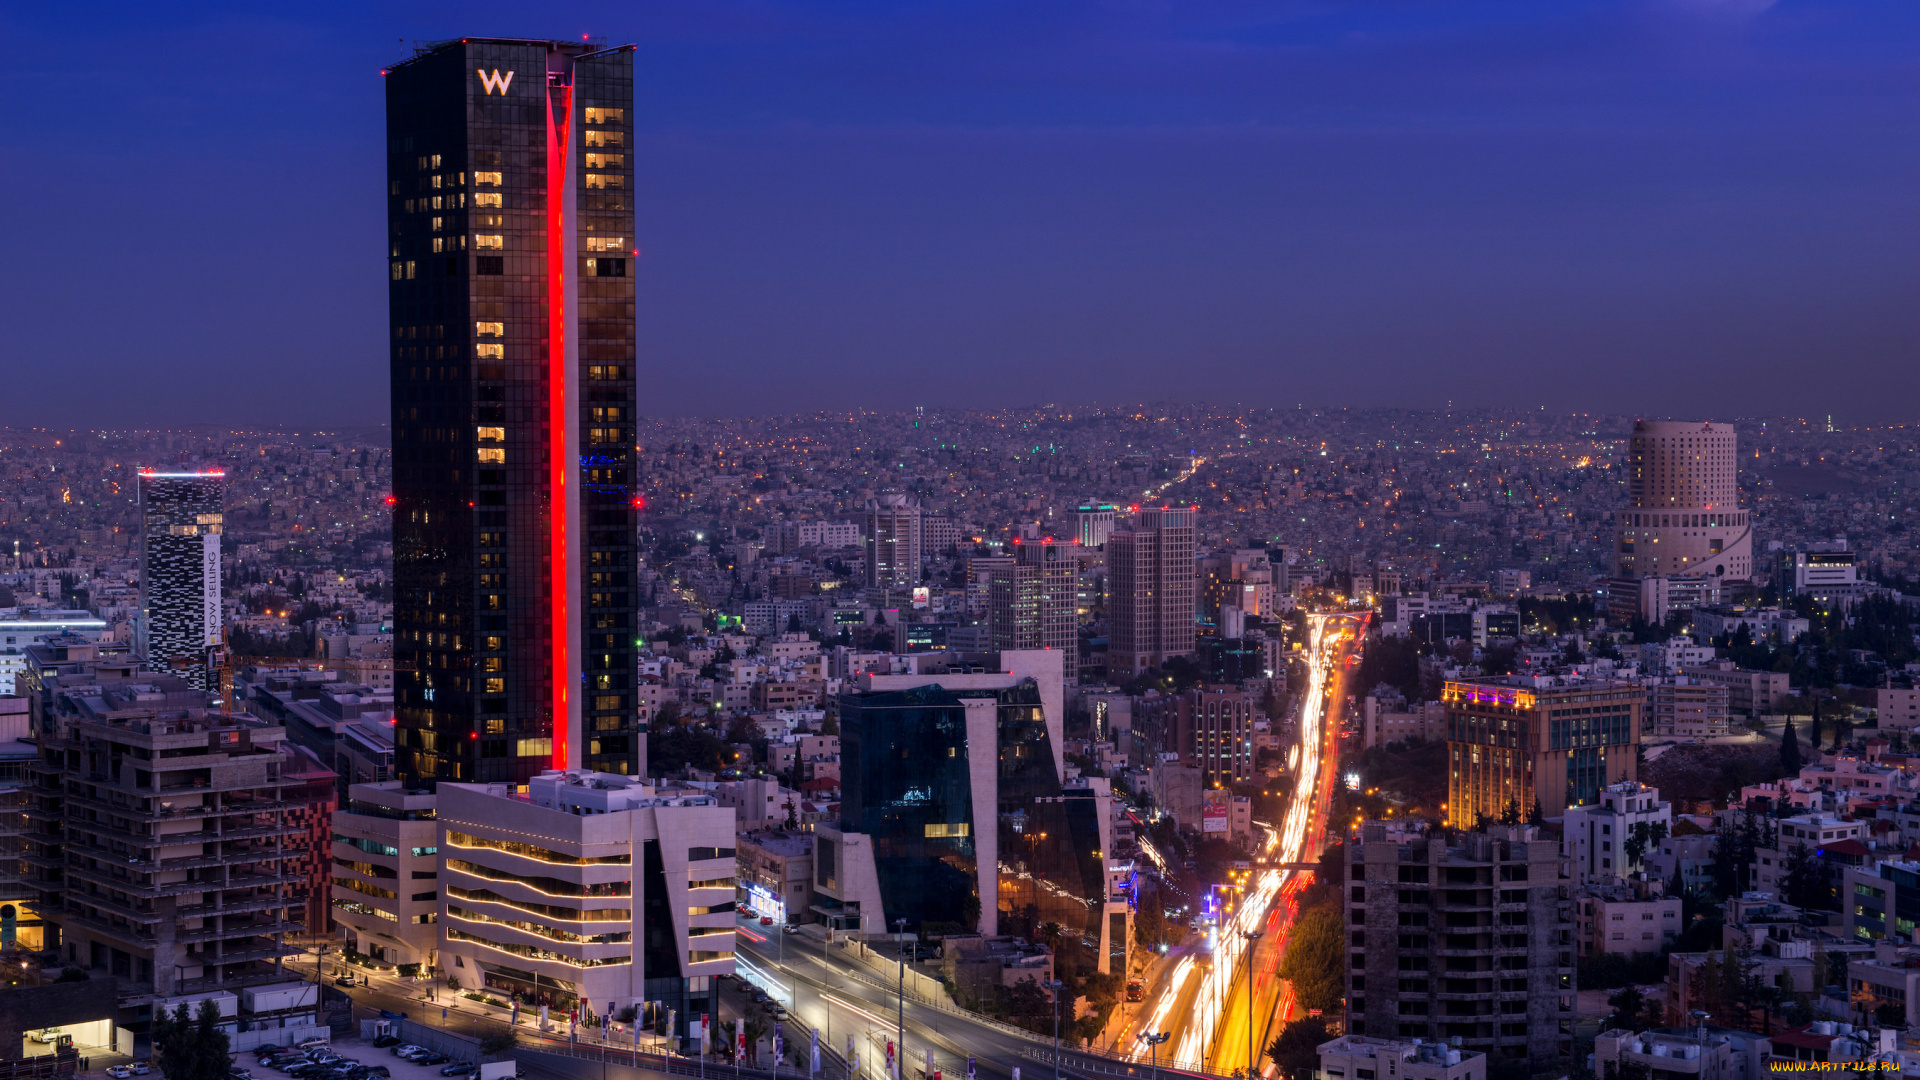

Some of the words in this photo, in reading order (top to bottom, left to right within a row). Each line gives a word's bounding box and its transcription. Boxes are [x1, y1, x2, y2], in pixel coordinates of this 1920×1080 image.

[477, 68, 515, 96] W
[208, 551, 217, 598] SELLING
[209, 602, 217, 636] NOW
